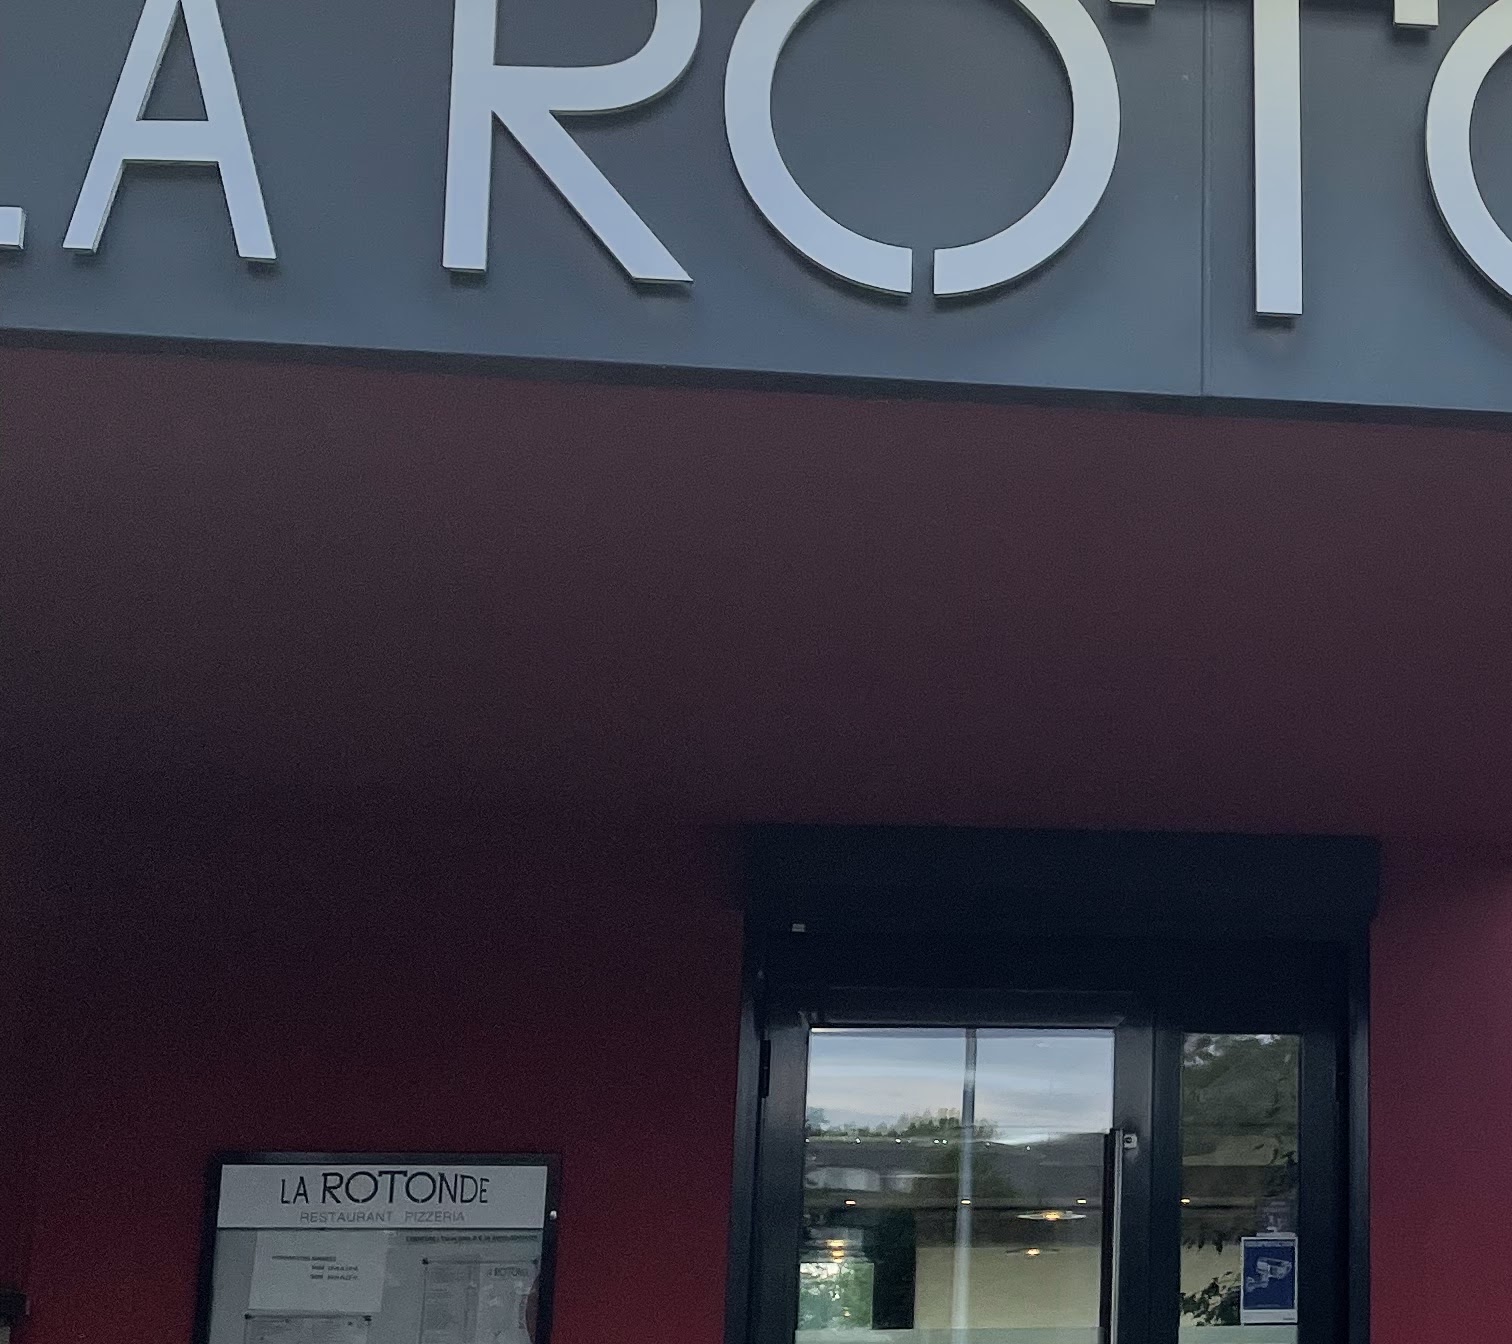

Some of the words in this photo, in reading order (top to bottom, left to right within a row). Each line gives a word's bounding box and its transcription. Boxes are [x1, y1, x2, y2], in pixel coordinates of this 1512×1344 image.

[280, 1175, 309, 1205] LA
[321, 1169, 490, 1204] ROTONDE
[300, 1210, 393, 1224] RESTAURANT
[404, 1210, 466, 1224] PIZZERIA
